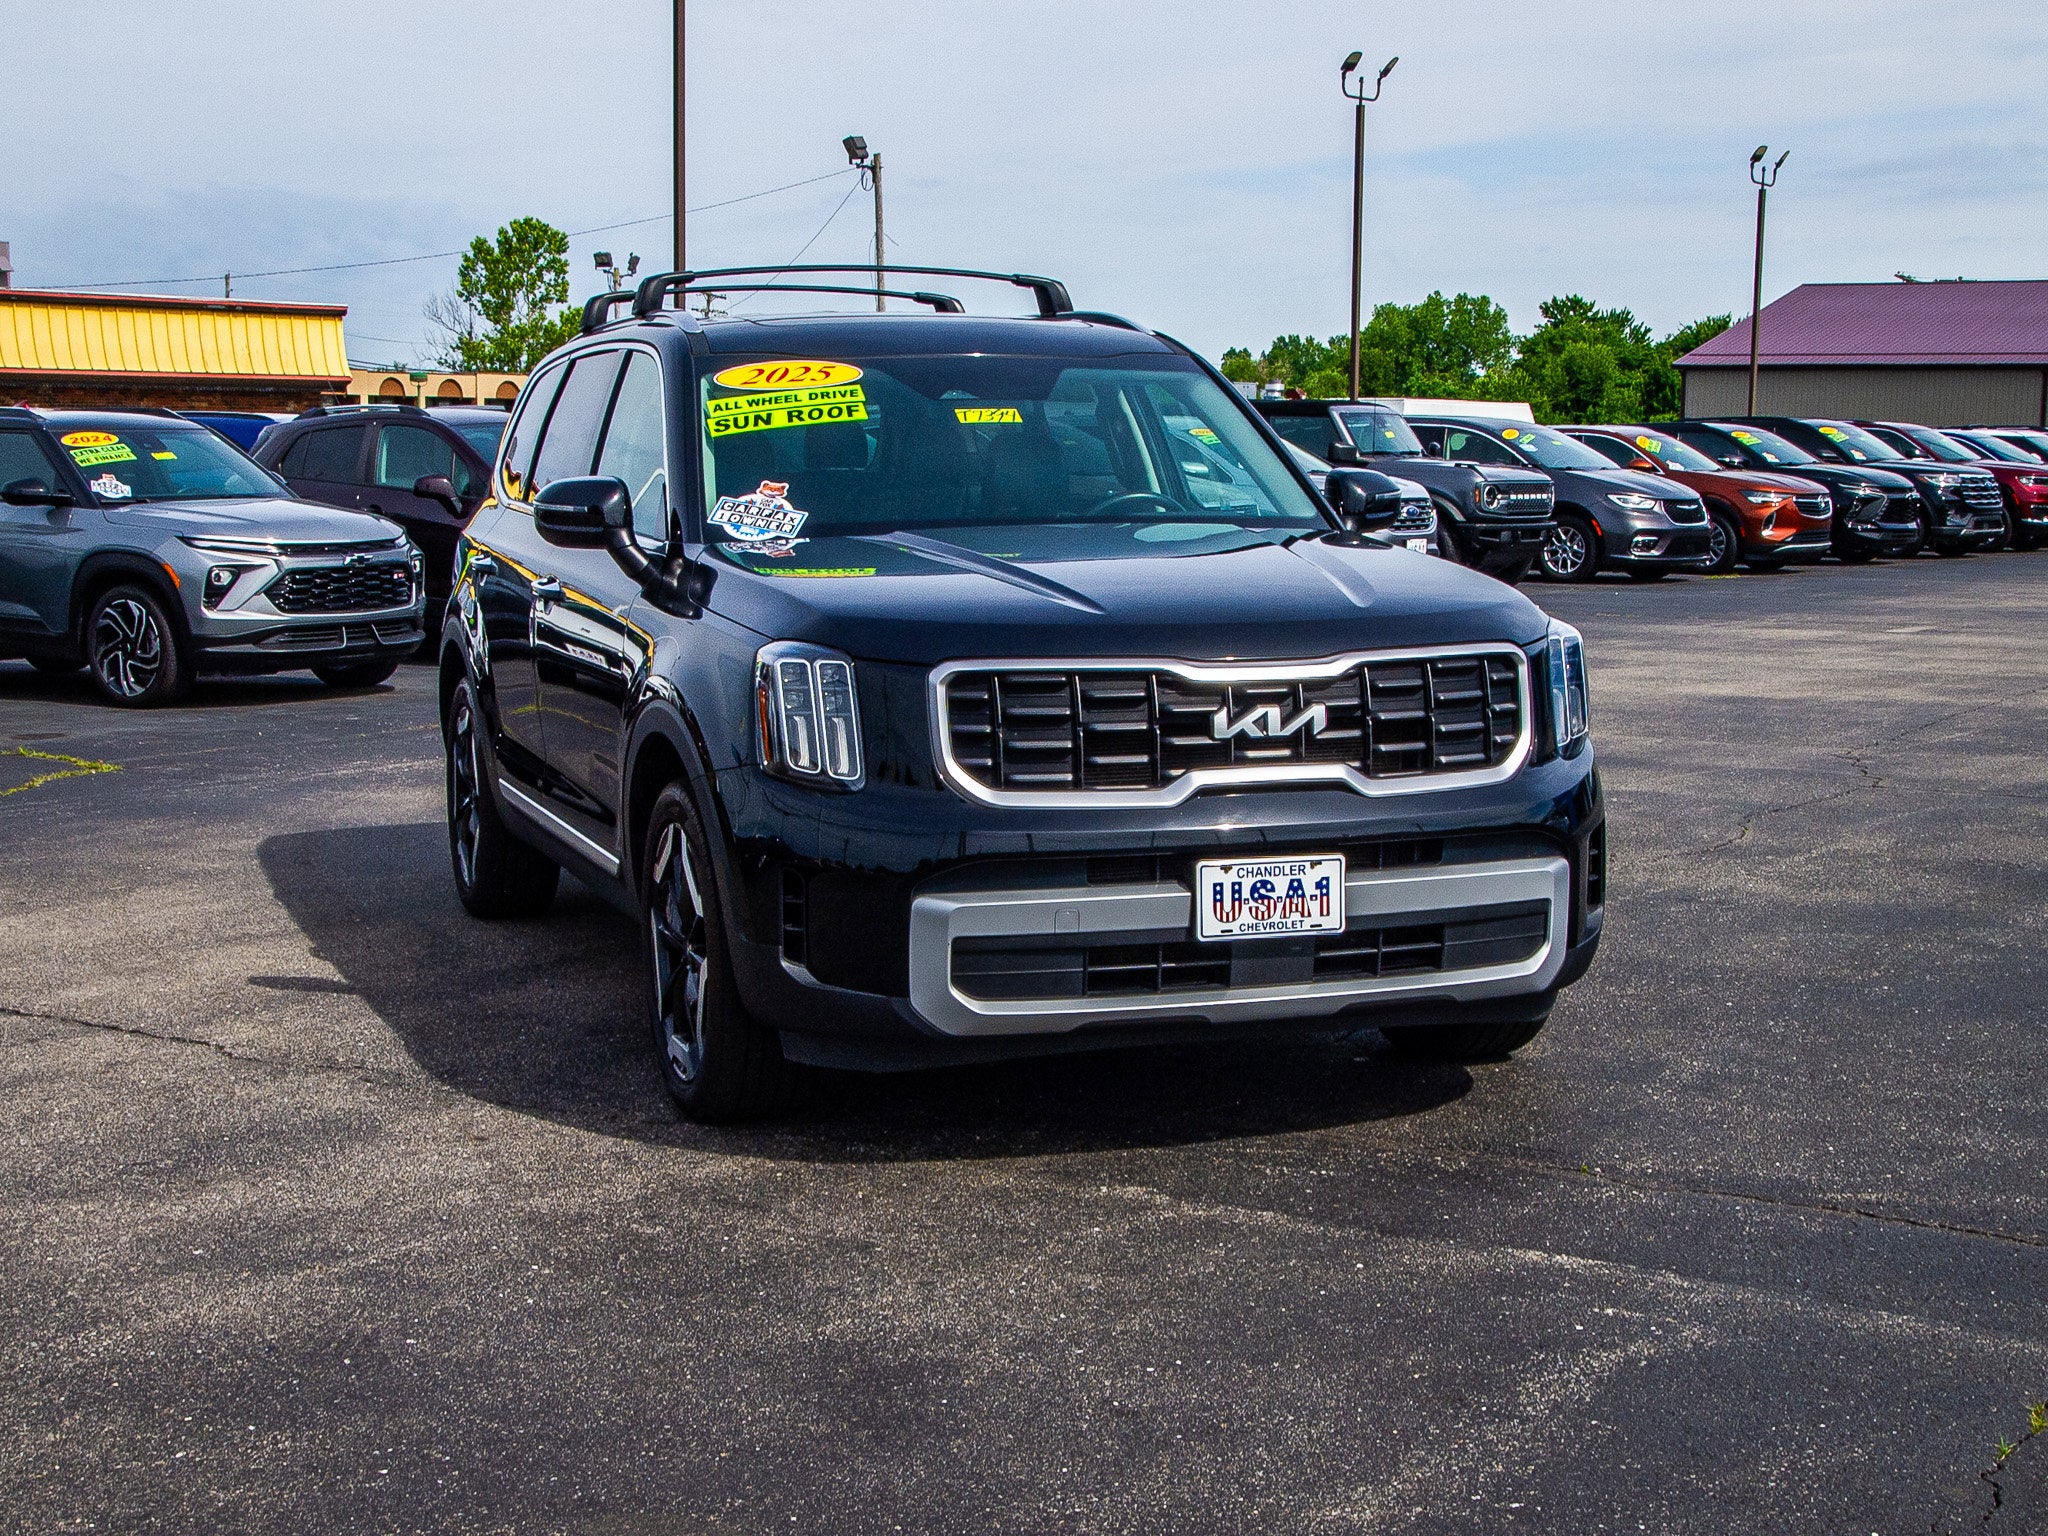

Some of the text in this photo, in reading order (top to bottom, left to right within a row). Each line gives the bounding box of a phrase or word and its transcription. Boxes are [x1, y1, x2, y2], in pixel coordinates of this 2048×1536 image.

[740, 366, 836, 385] 2025
[713, 389, 859, 413] ALL WHEEL DRIVE
[713, 404, 859, 433] SUN ROOF
[69, 435, 112, 445] 2024
[73, 445, 127, 457] EXTRA CLEAN
[78, 452, 132, 465] WE FINANCE
[721, 502, 797, 523] CARFAX
[728, 514, 794, 533] OWNER
[1213, 703, 1328, 739] KIA
[1237, 864, 1306, 879] CHANDLER
[1239, 919, 1305, 932] CHEVROLET
